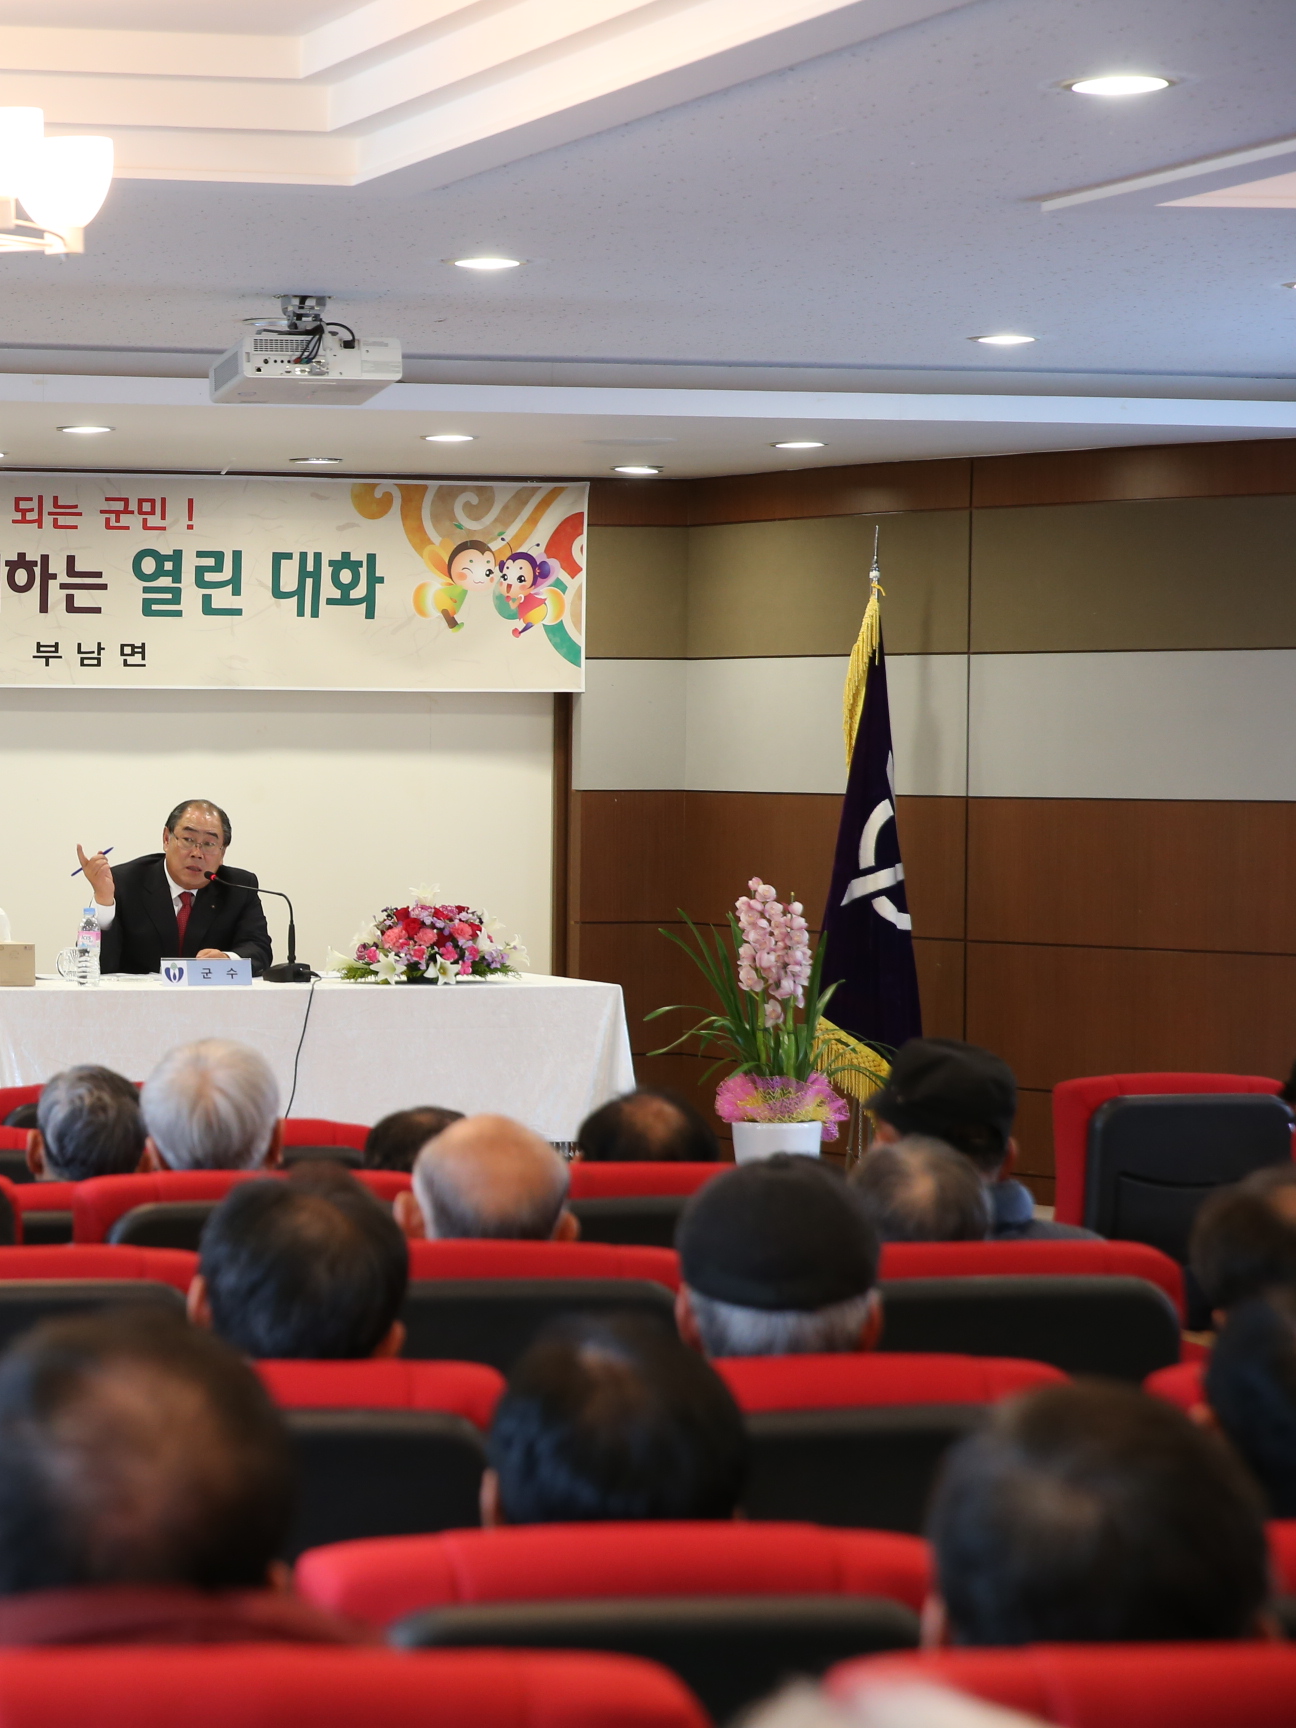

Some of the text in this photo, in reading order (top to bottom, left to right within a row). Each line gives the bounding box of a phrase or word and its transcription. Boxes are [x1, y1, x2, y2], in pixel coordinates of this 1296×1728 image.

[12, 495, 83, 530] 되는
[131, 548, 243, 618] 열린
[271, 551, 385, 620] 대화
